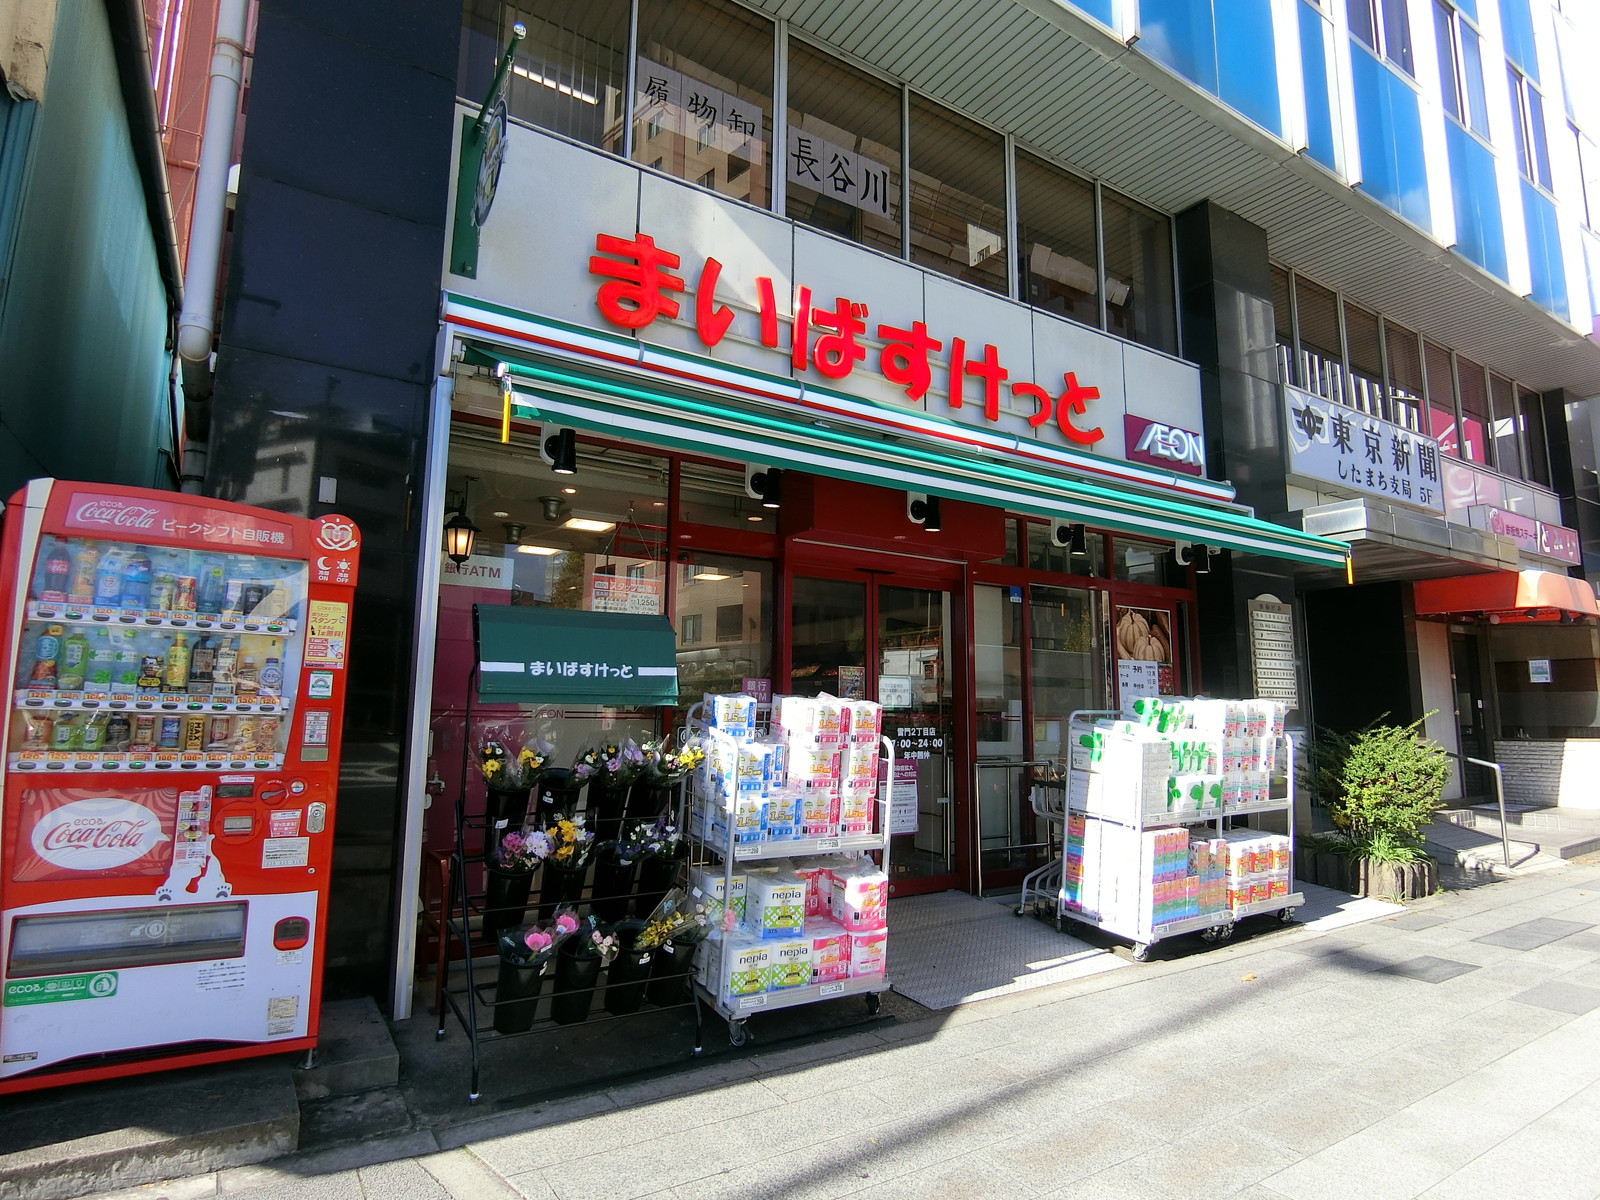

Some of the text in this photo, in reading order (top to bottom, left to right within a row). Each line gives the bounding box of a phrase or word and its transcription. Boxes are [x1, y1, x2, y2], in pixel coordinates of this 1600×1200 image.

[643, 76, 889, 214] 履物卸 長谷川
[589, 232, 1104, 446] まいばすけっと
[1134, 423, 1204, 466] AEON
[1330, 412, 1437, 483] 東京新聞
[1338, 459, 1433, 505] したまち支局 5F
[76, 501, 159, 529] Coca-Cola
[162, 518, 285, 545] ピークシフト自販機
[444, 562, 501, 579] 銀行ATM
[529, 660, 634, 679] まいばすけっと
[747, 680, 767, 691] 銀行
[194, 722, 202, 741] MAX
[903, 750, 931, 760] 年中無休
[43, 820, 151, 850] Coca-Cola
[772, 890, 802, 900] nepia
[739, 951, 768, 965] nepia
[780, 946, 808, 958] nepia
